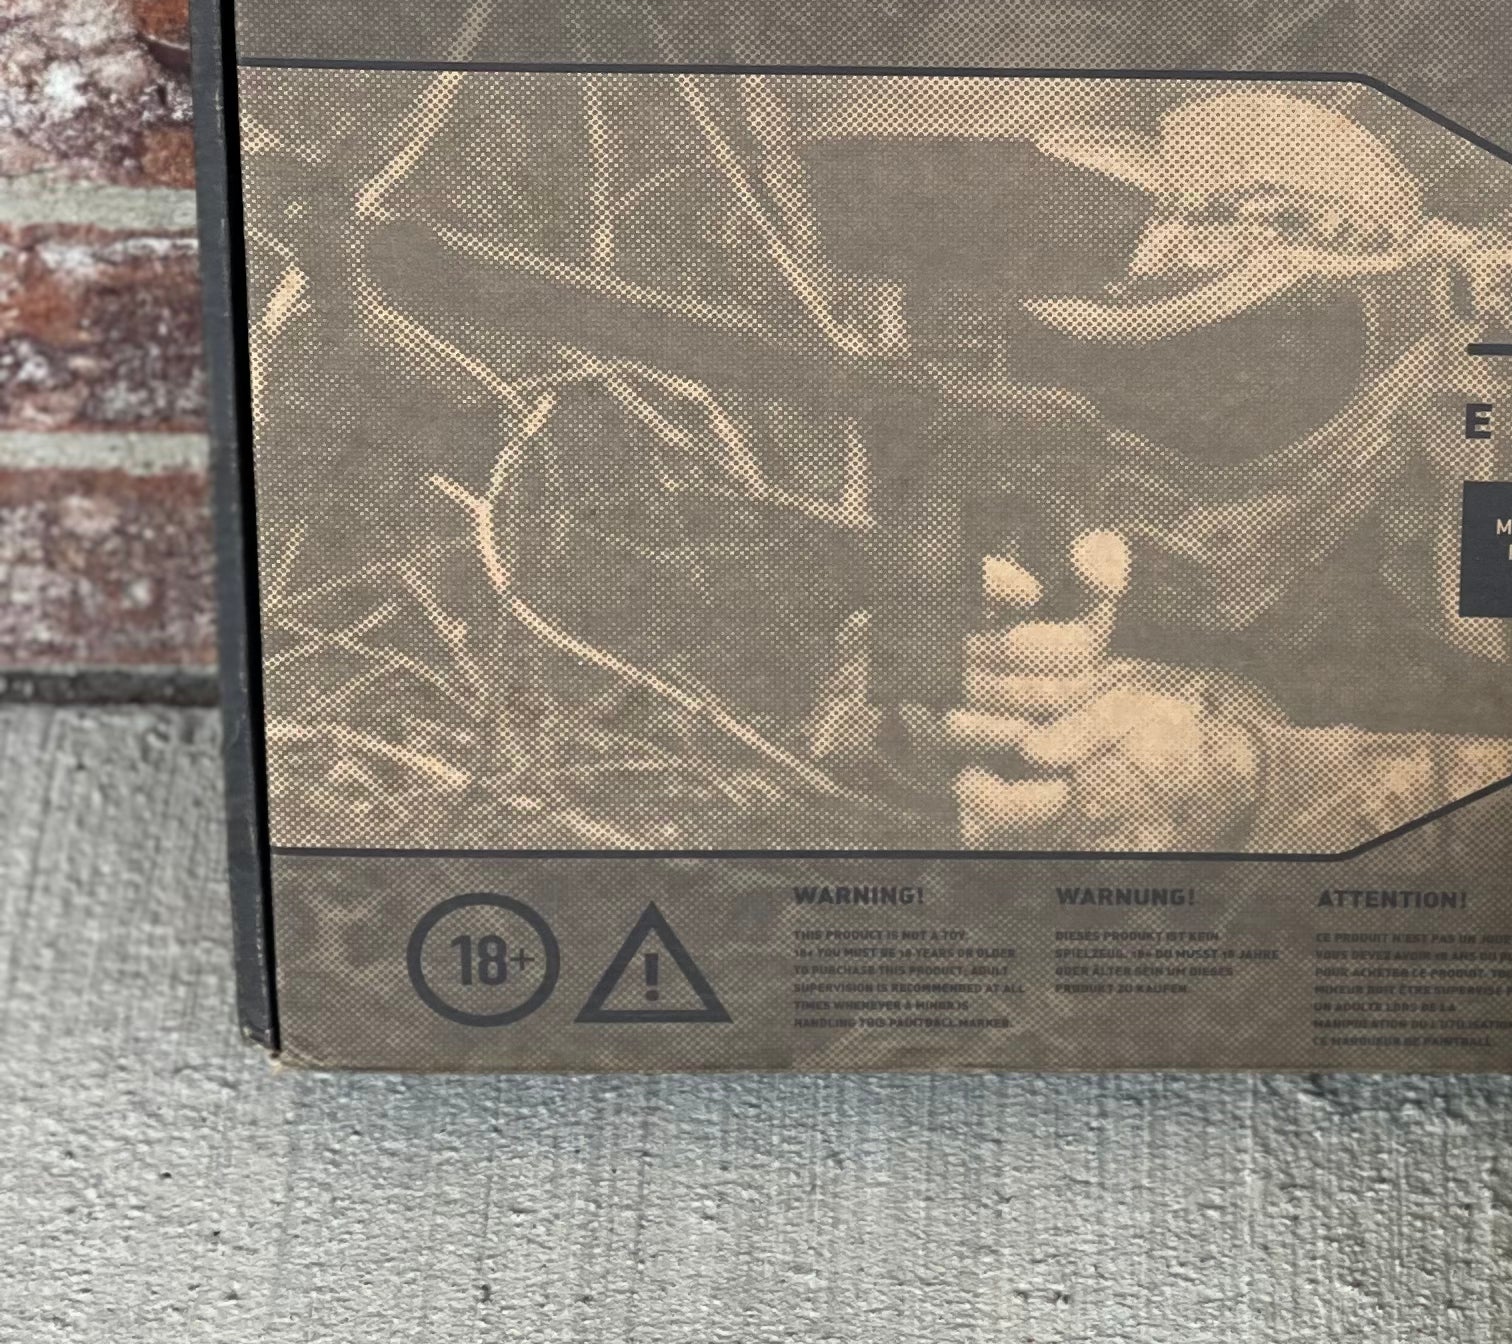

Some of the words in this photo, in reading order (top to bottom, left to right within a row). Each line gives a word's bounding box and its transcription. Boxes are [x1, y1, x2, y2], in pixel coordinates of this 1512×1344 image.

[793, 886, 924, 905] WARNING!
[1056, 887, 1195, 906] WARNUNG!
[1318, 889, 1467, 908] ATTENTION!
[826, 930, 882, 940] PRODUCT
[887, 930, 897, 940] IS
[902, 930, 926, 940] NOT
[450, 933, 536, 986] 18+
